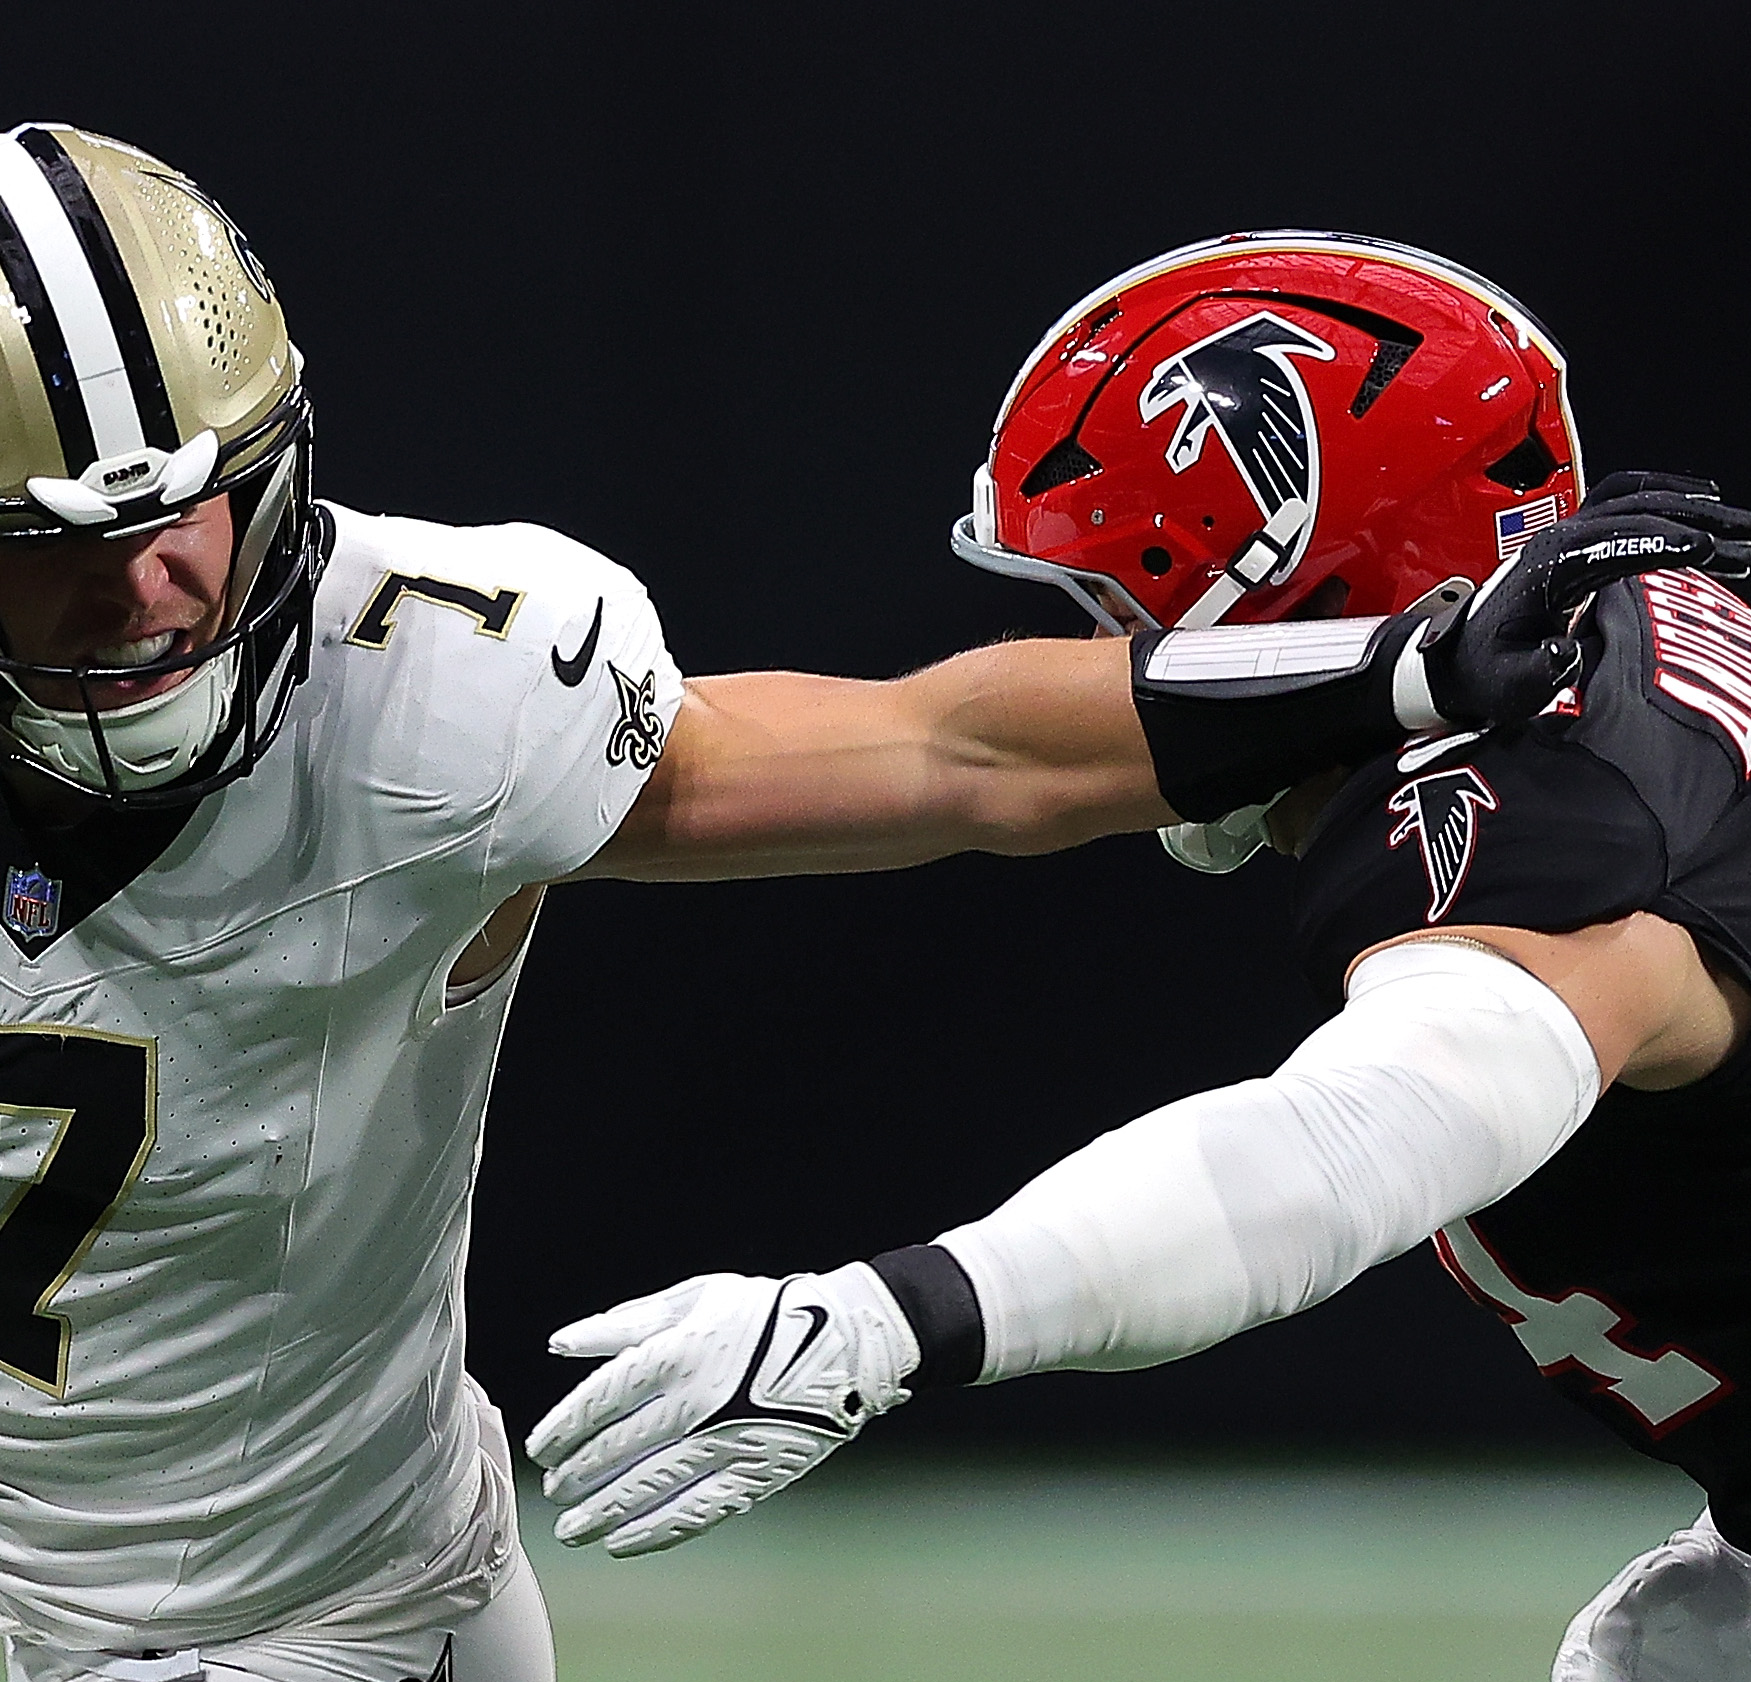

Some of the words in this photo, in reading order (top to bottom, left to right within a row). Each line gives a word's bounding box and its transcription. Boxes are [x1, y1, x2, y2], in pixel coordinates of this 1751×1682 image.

[1586, 536, 1665, 564] ADIZERO
[342, 568, 528, 651] 7
[10, 894, 51, 928] NFL
